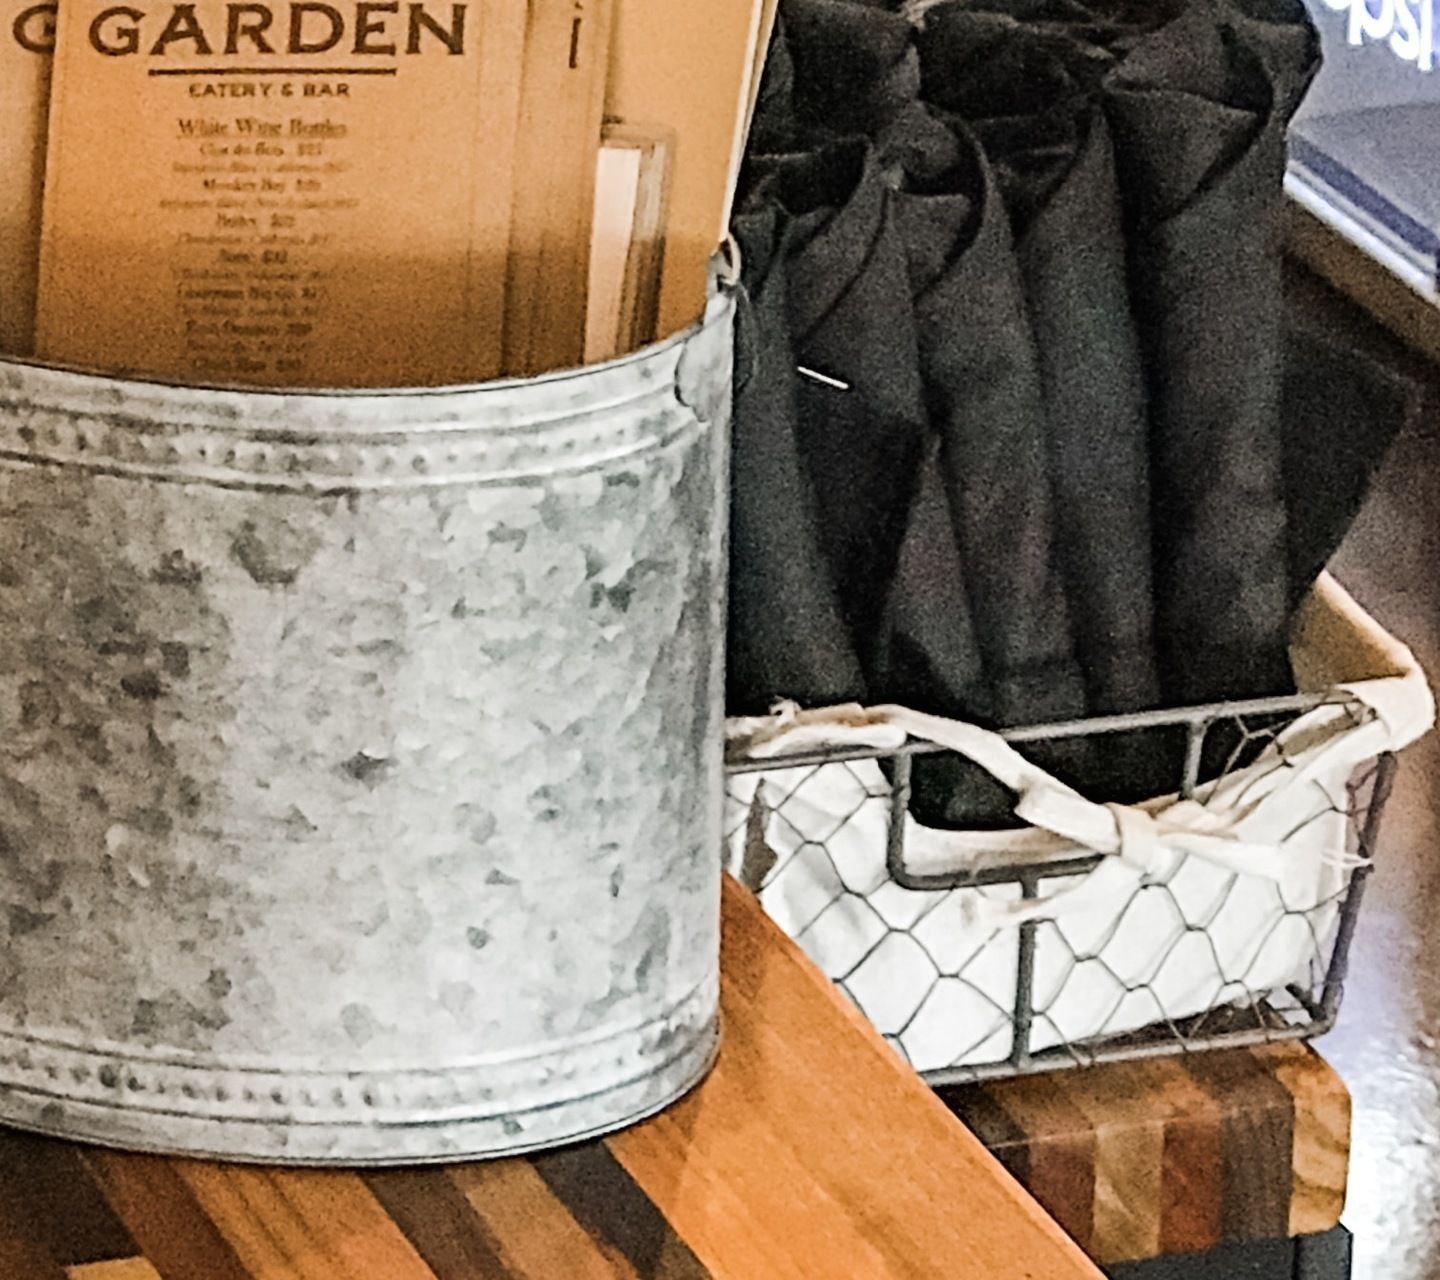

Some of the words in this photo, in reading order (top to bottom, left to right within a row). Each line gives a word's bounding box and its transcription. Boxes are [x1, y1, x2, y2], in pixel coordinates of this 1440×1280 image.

[88, 0, 469, 57] GARDEN
[188, 82, 274, 99] EATERY
[280, 82, 295, 99] &
[302, 82, 351, 99] BAR
[176, 118, 229, 138] White
[235, 118, 283, 137] Wine
